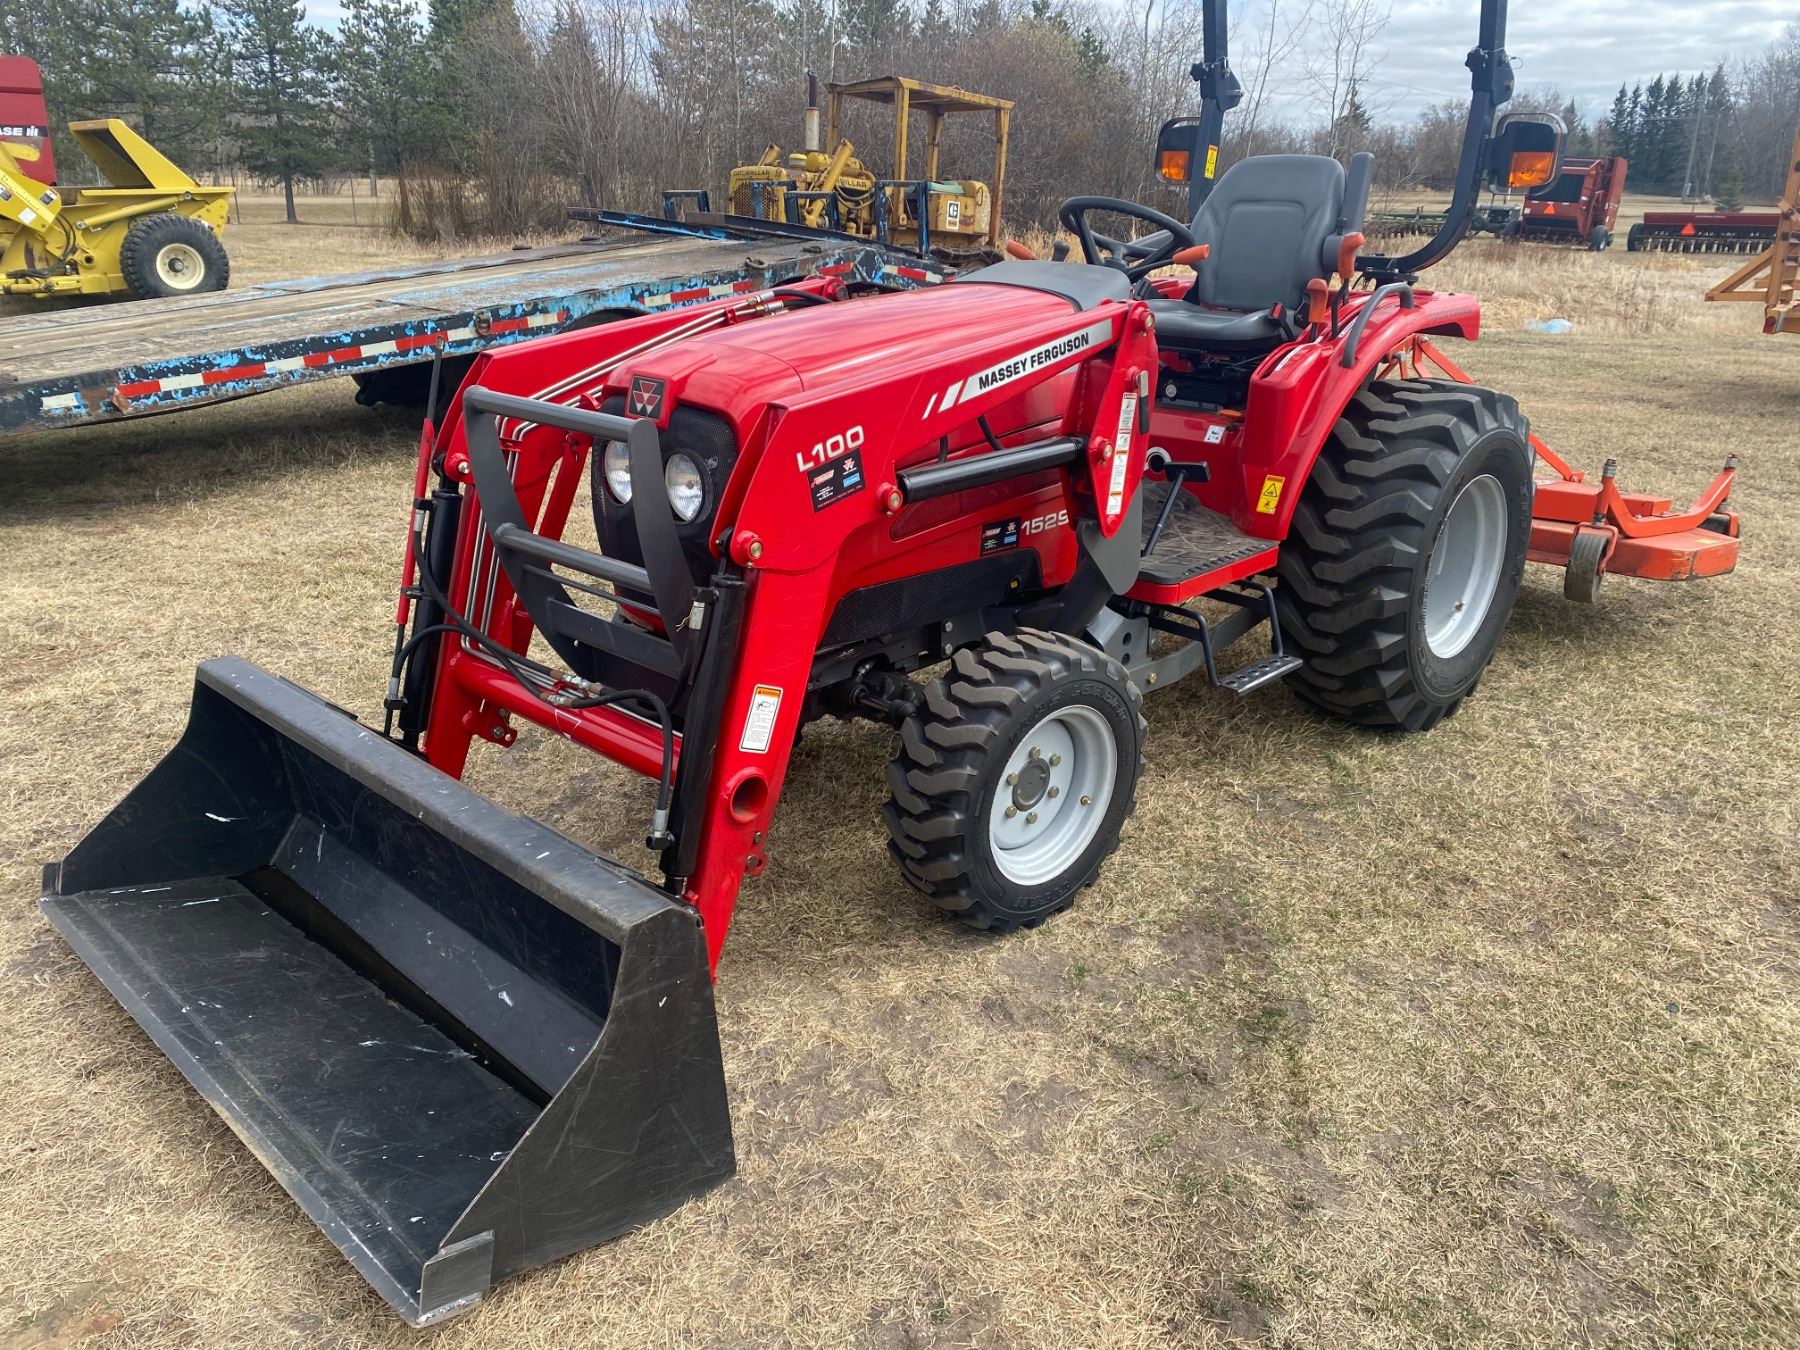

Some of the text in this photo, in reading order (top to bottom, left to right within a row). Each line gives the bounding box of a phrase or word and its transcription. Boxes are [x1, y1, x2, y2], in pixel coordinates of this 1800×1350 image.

[978, 332, 1089, 390] MASSEY FERGUSON
[796, 424, 865, 473] L100
